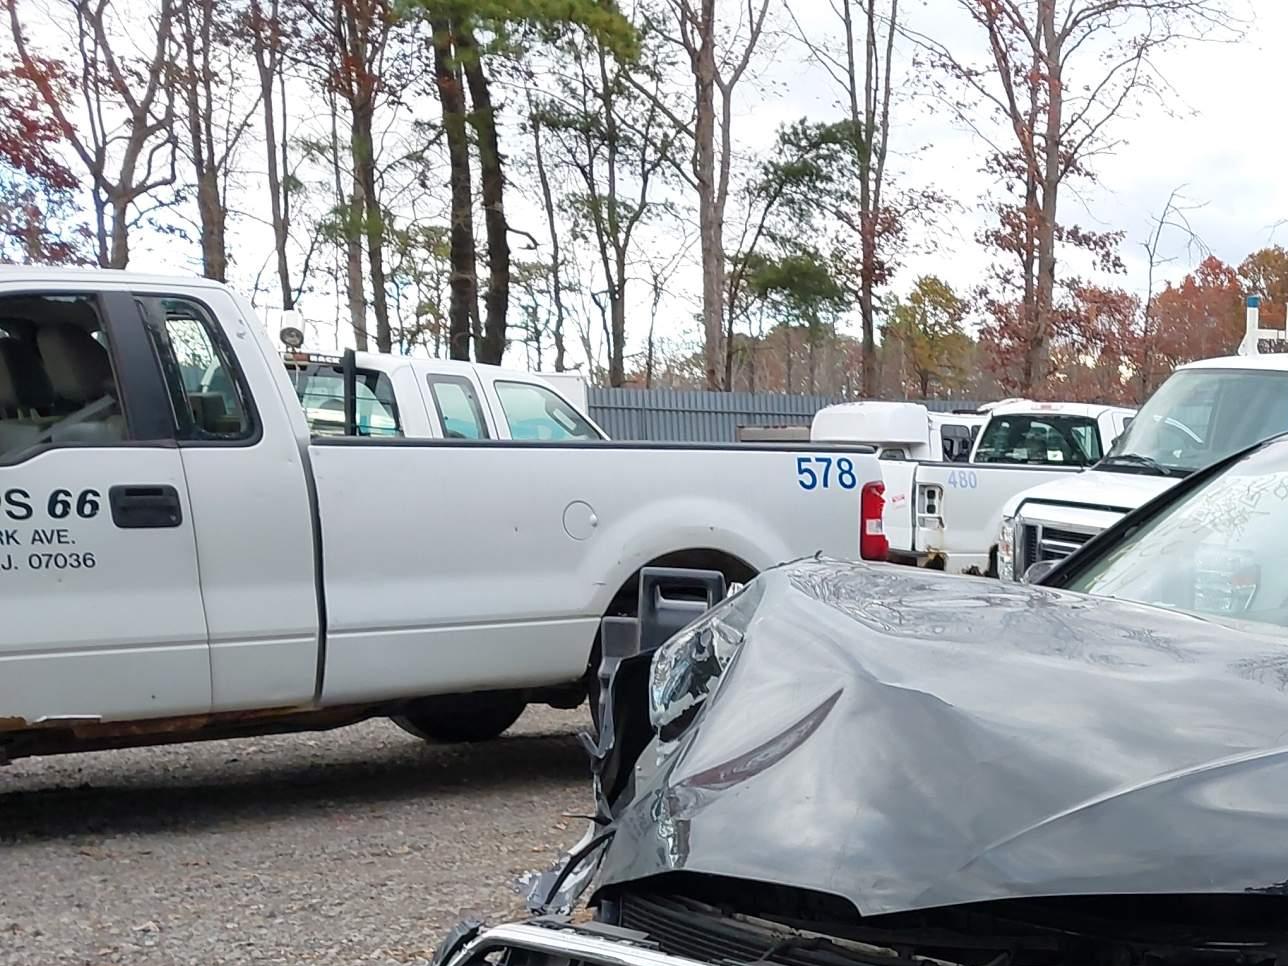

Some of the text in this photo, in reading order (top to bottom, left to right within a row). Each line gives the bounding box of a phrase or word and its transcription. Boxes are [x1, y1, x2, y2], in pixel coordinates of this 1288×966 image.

[797, 457, 857, 490] 578
[948, 471, 977, 489] 480
[0, 489, 101, 520] S 66
[31, 529, 76, 545] AVE.
[28, 552, 96, 569] 07036
